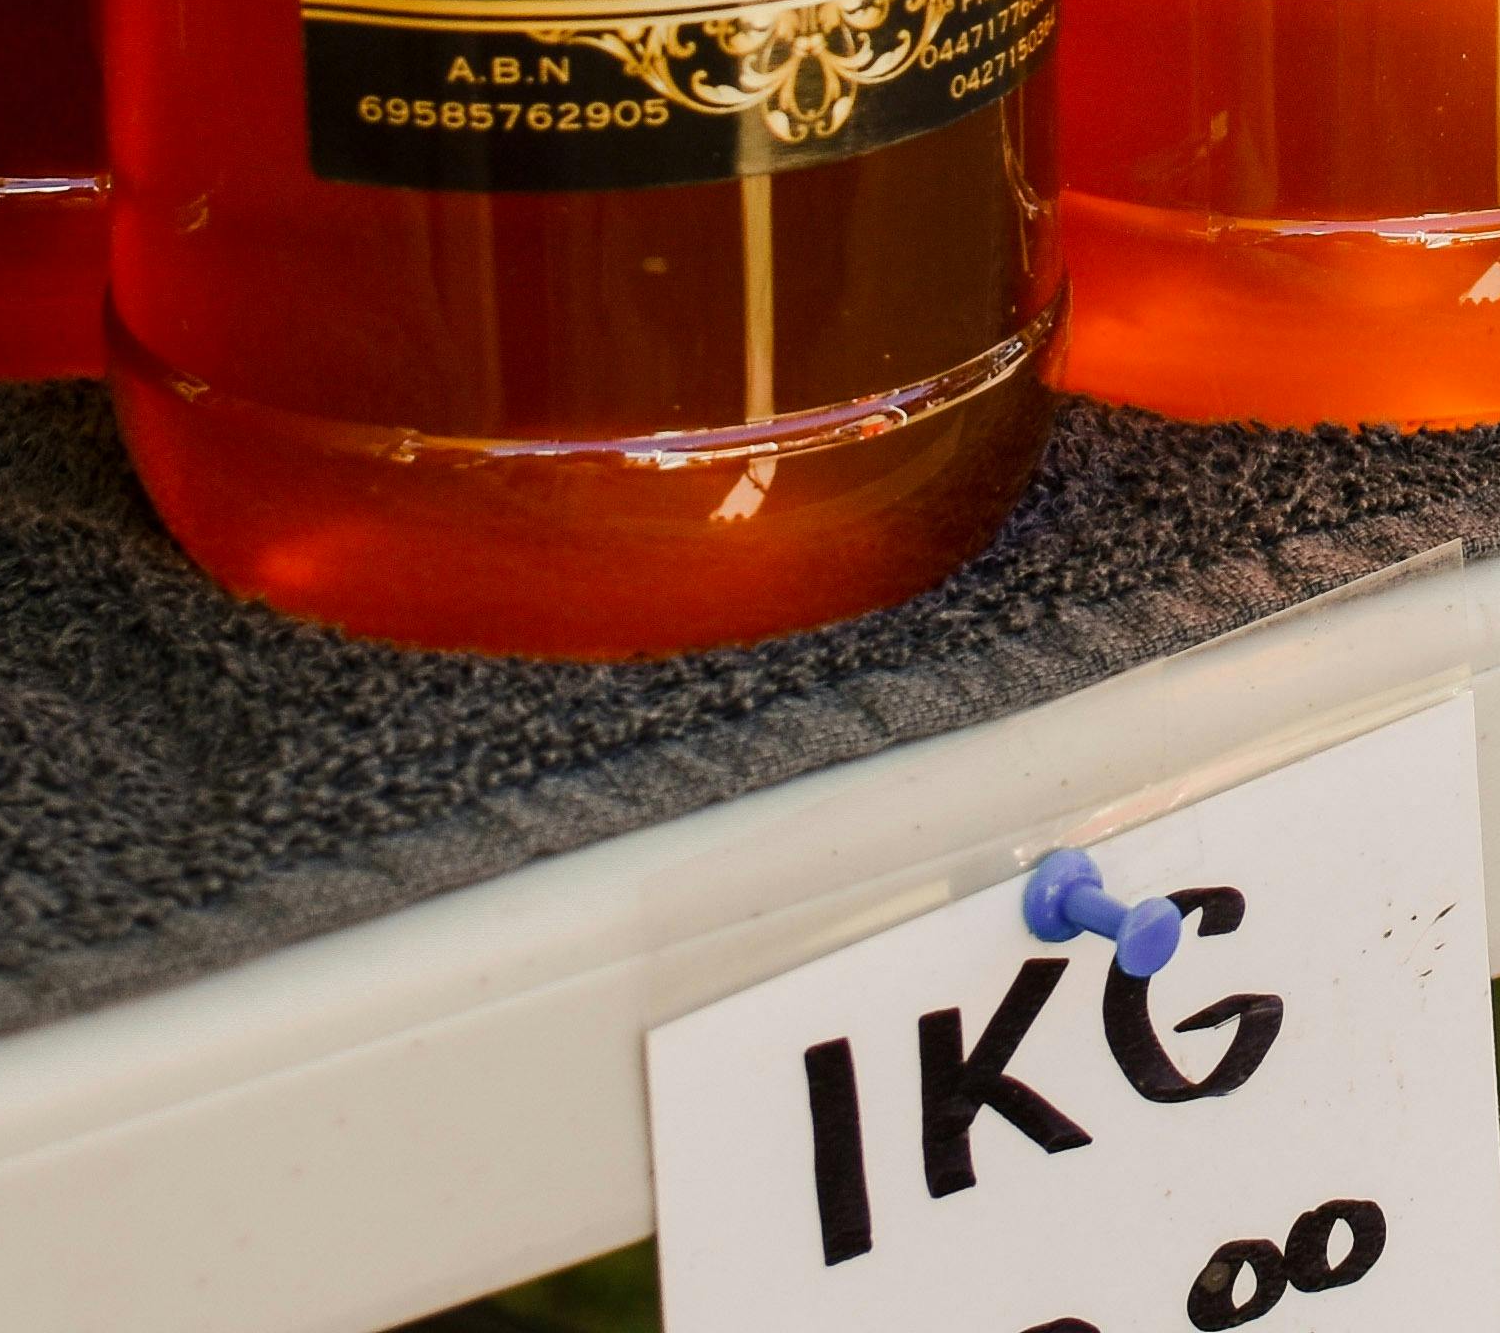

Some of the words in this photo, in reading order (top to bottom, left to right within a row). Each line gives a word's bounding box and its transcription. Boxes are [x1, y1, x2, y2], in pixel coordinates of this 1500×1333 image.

[447, 55, 571, 85] A.B.N
[358, 95, 669, 132] 69585762905
[804, 886, 1285, 1268] 1KG
